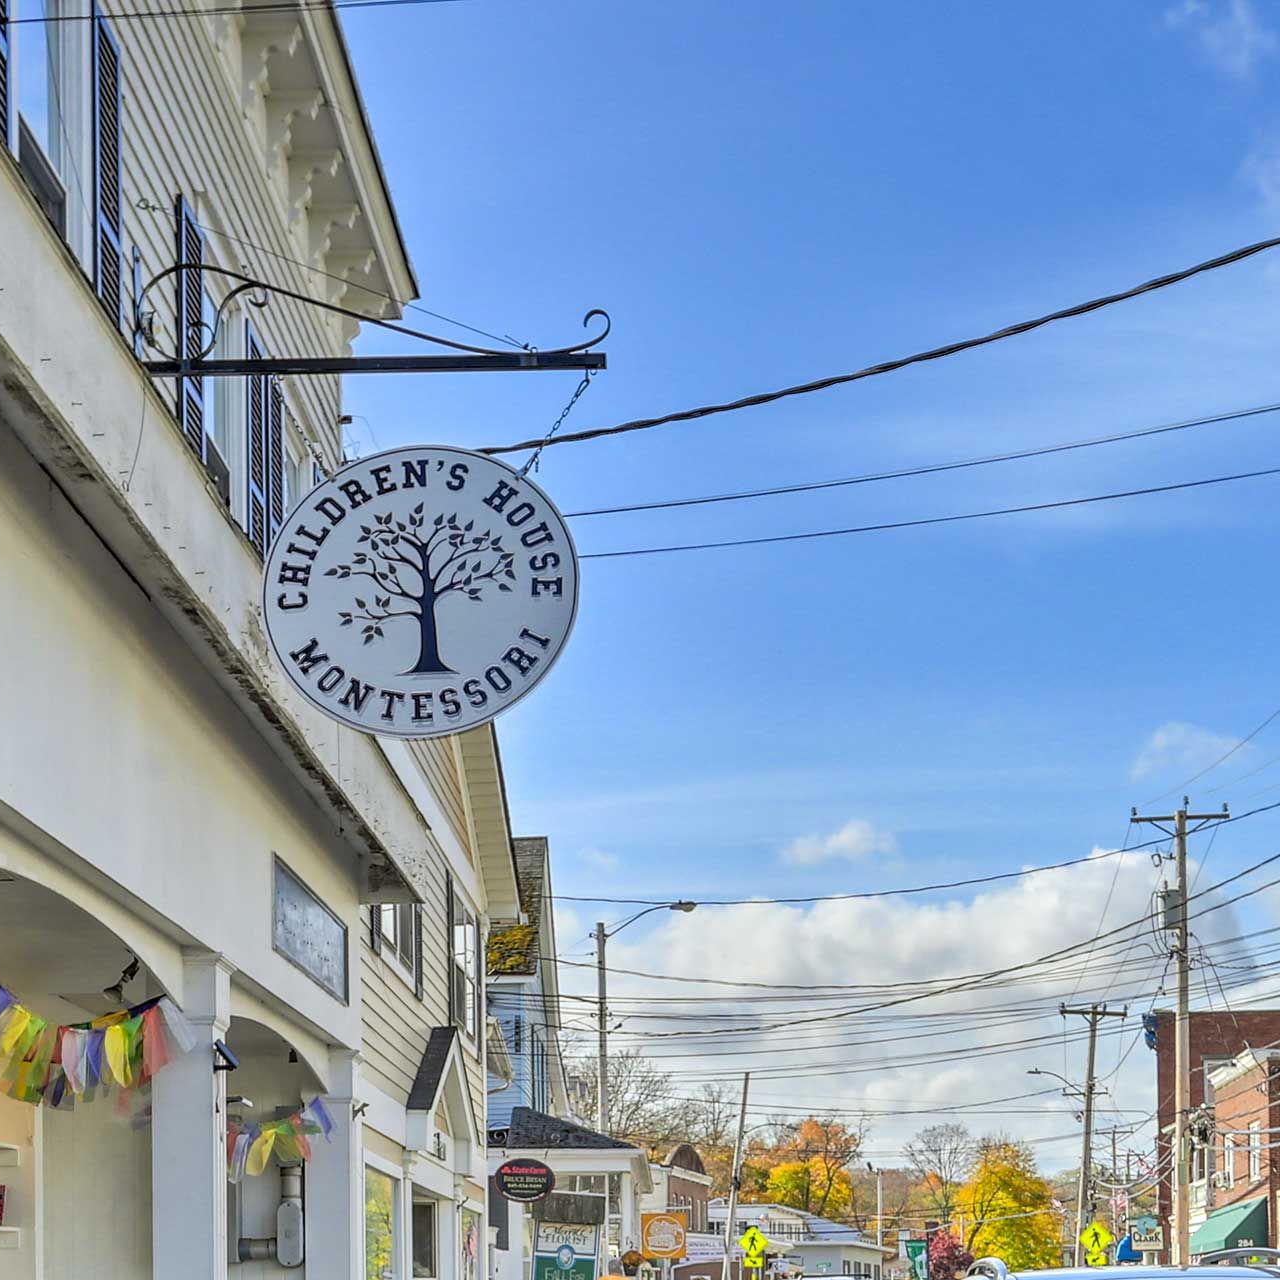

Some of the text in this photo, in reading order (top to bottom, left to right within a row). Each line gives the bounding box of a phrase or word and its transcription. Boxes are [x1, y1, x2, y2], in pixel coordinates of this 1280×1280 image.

[277, 459, 563, 612] CHILDREN'S HOUSE
[288, 627, 551, 723] MONTESSORI
[544, 1232, 589, 1246] FLORIST
[1133, 1231, 1161, 1242] CLARK
[1237, 1239, 1254, 1247] 284
